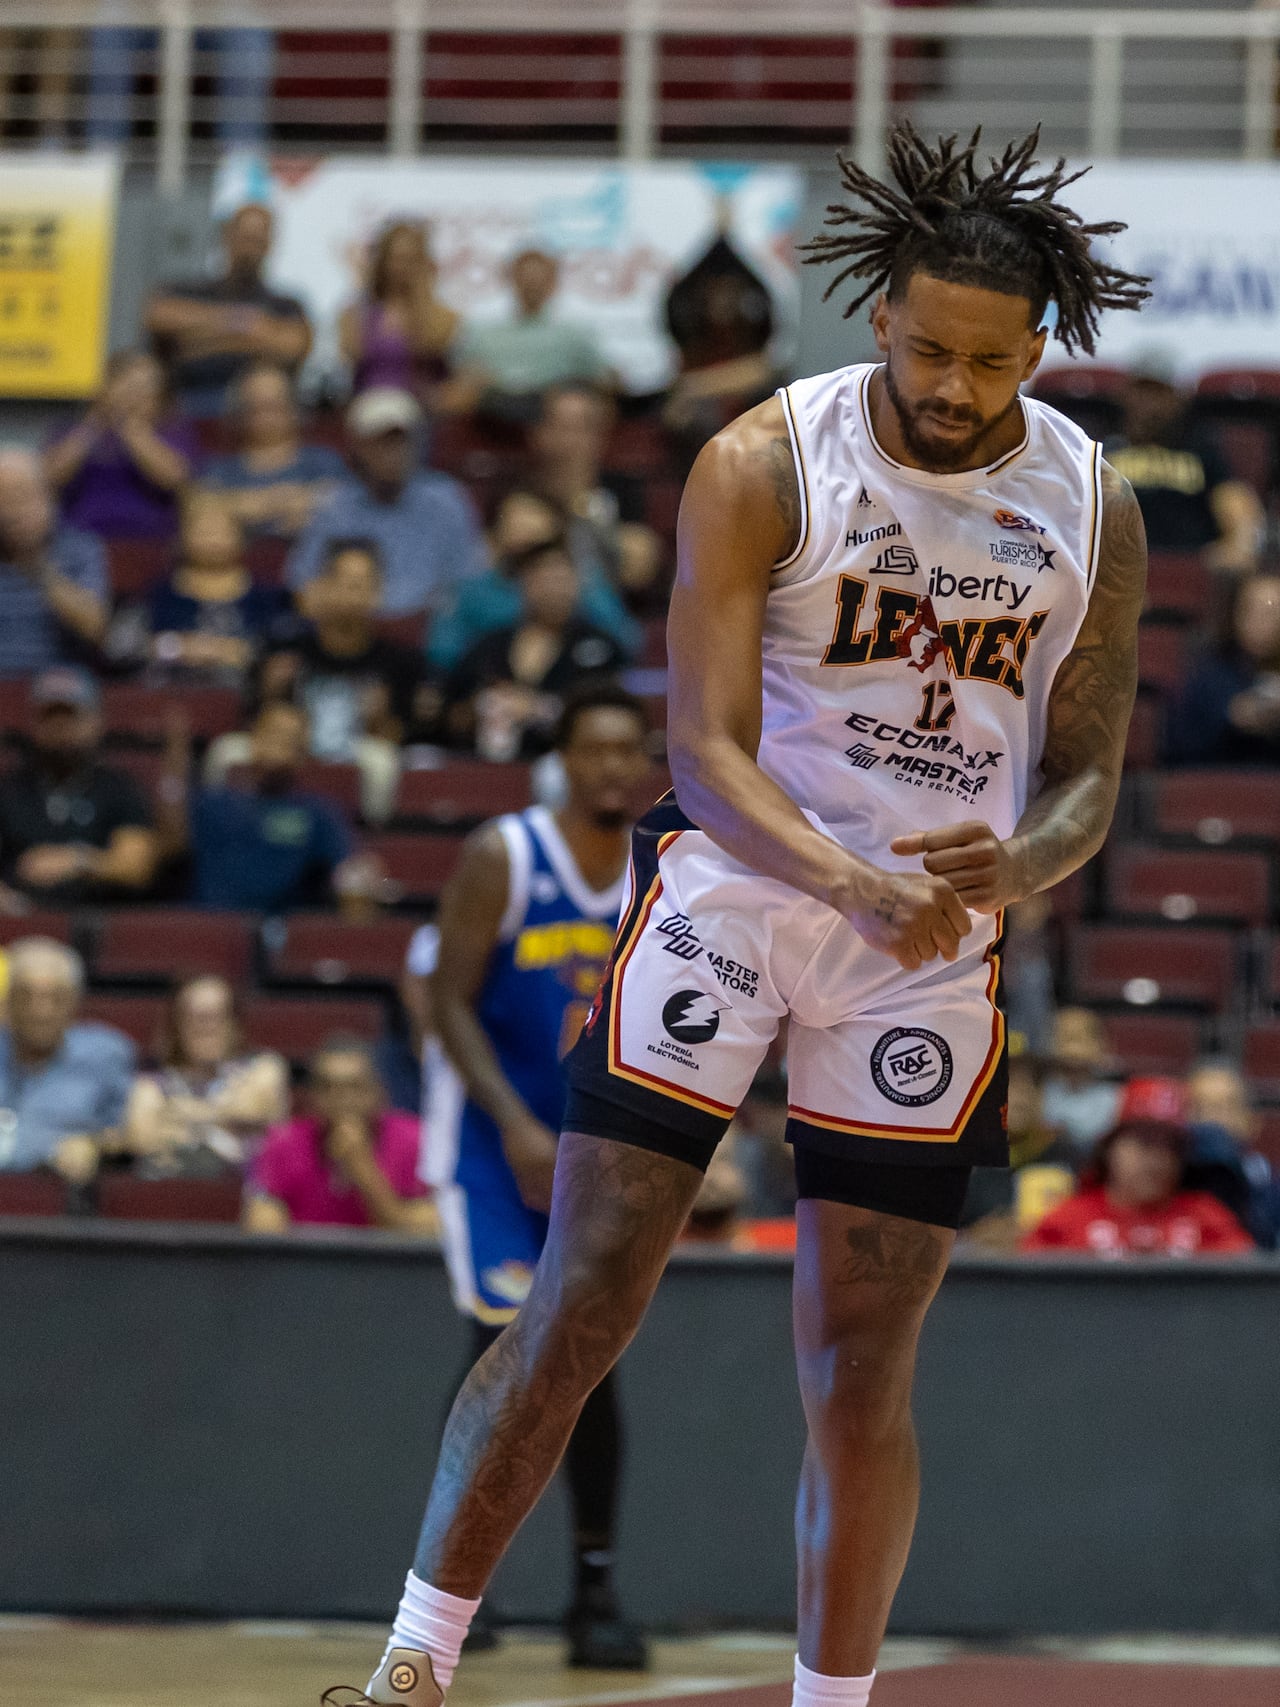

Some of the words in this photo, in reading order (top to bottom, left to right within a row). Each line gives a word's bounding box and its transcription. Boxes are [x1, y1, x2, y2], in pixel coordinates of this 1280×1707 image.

[989, 543, 1038, 561] TURISMO
[992, 555, 1018, 566] PUERTO
[1020, 560, 1037, 569] RICO
[929, 566, 1032, 610] iberty
[884, 752, 988, 795] MASTER
[895, 772, 924, 787] CAR
[928, 781, 977, 805] RENTAL
[714, 968, 758, 999] TORS
[647, 1044, 700, 1071] ELECTRÓNICA
[660, 1040, 693, 1059] LOTERÍA
[890, 1049, 933, 1077] RAC
